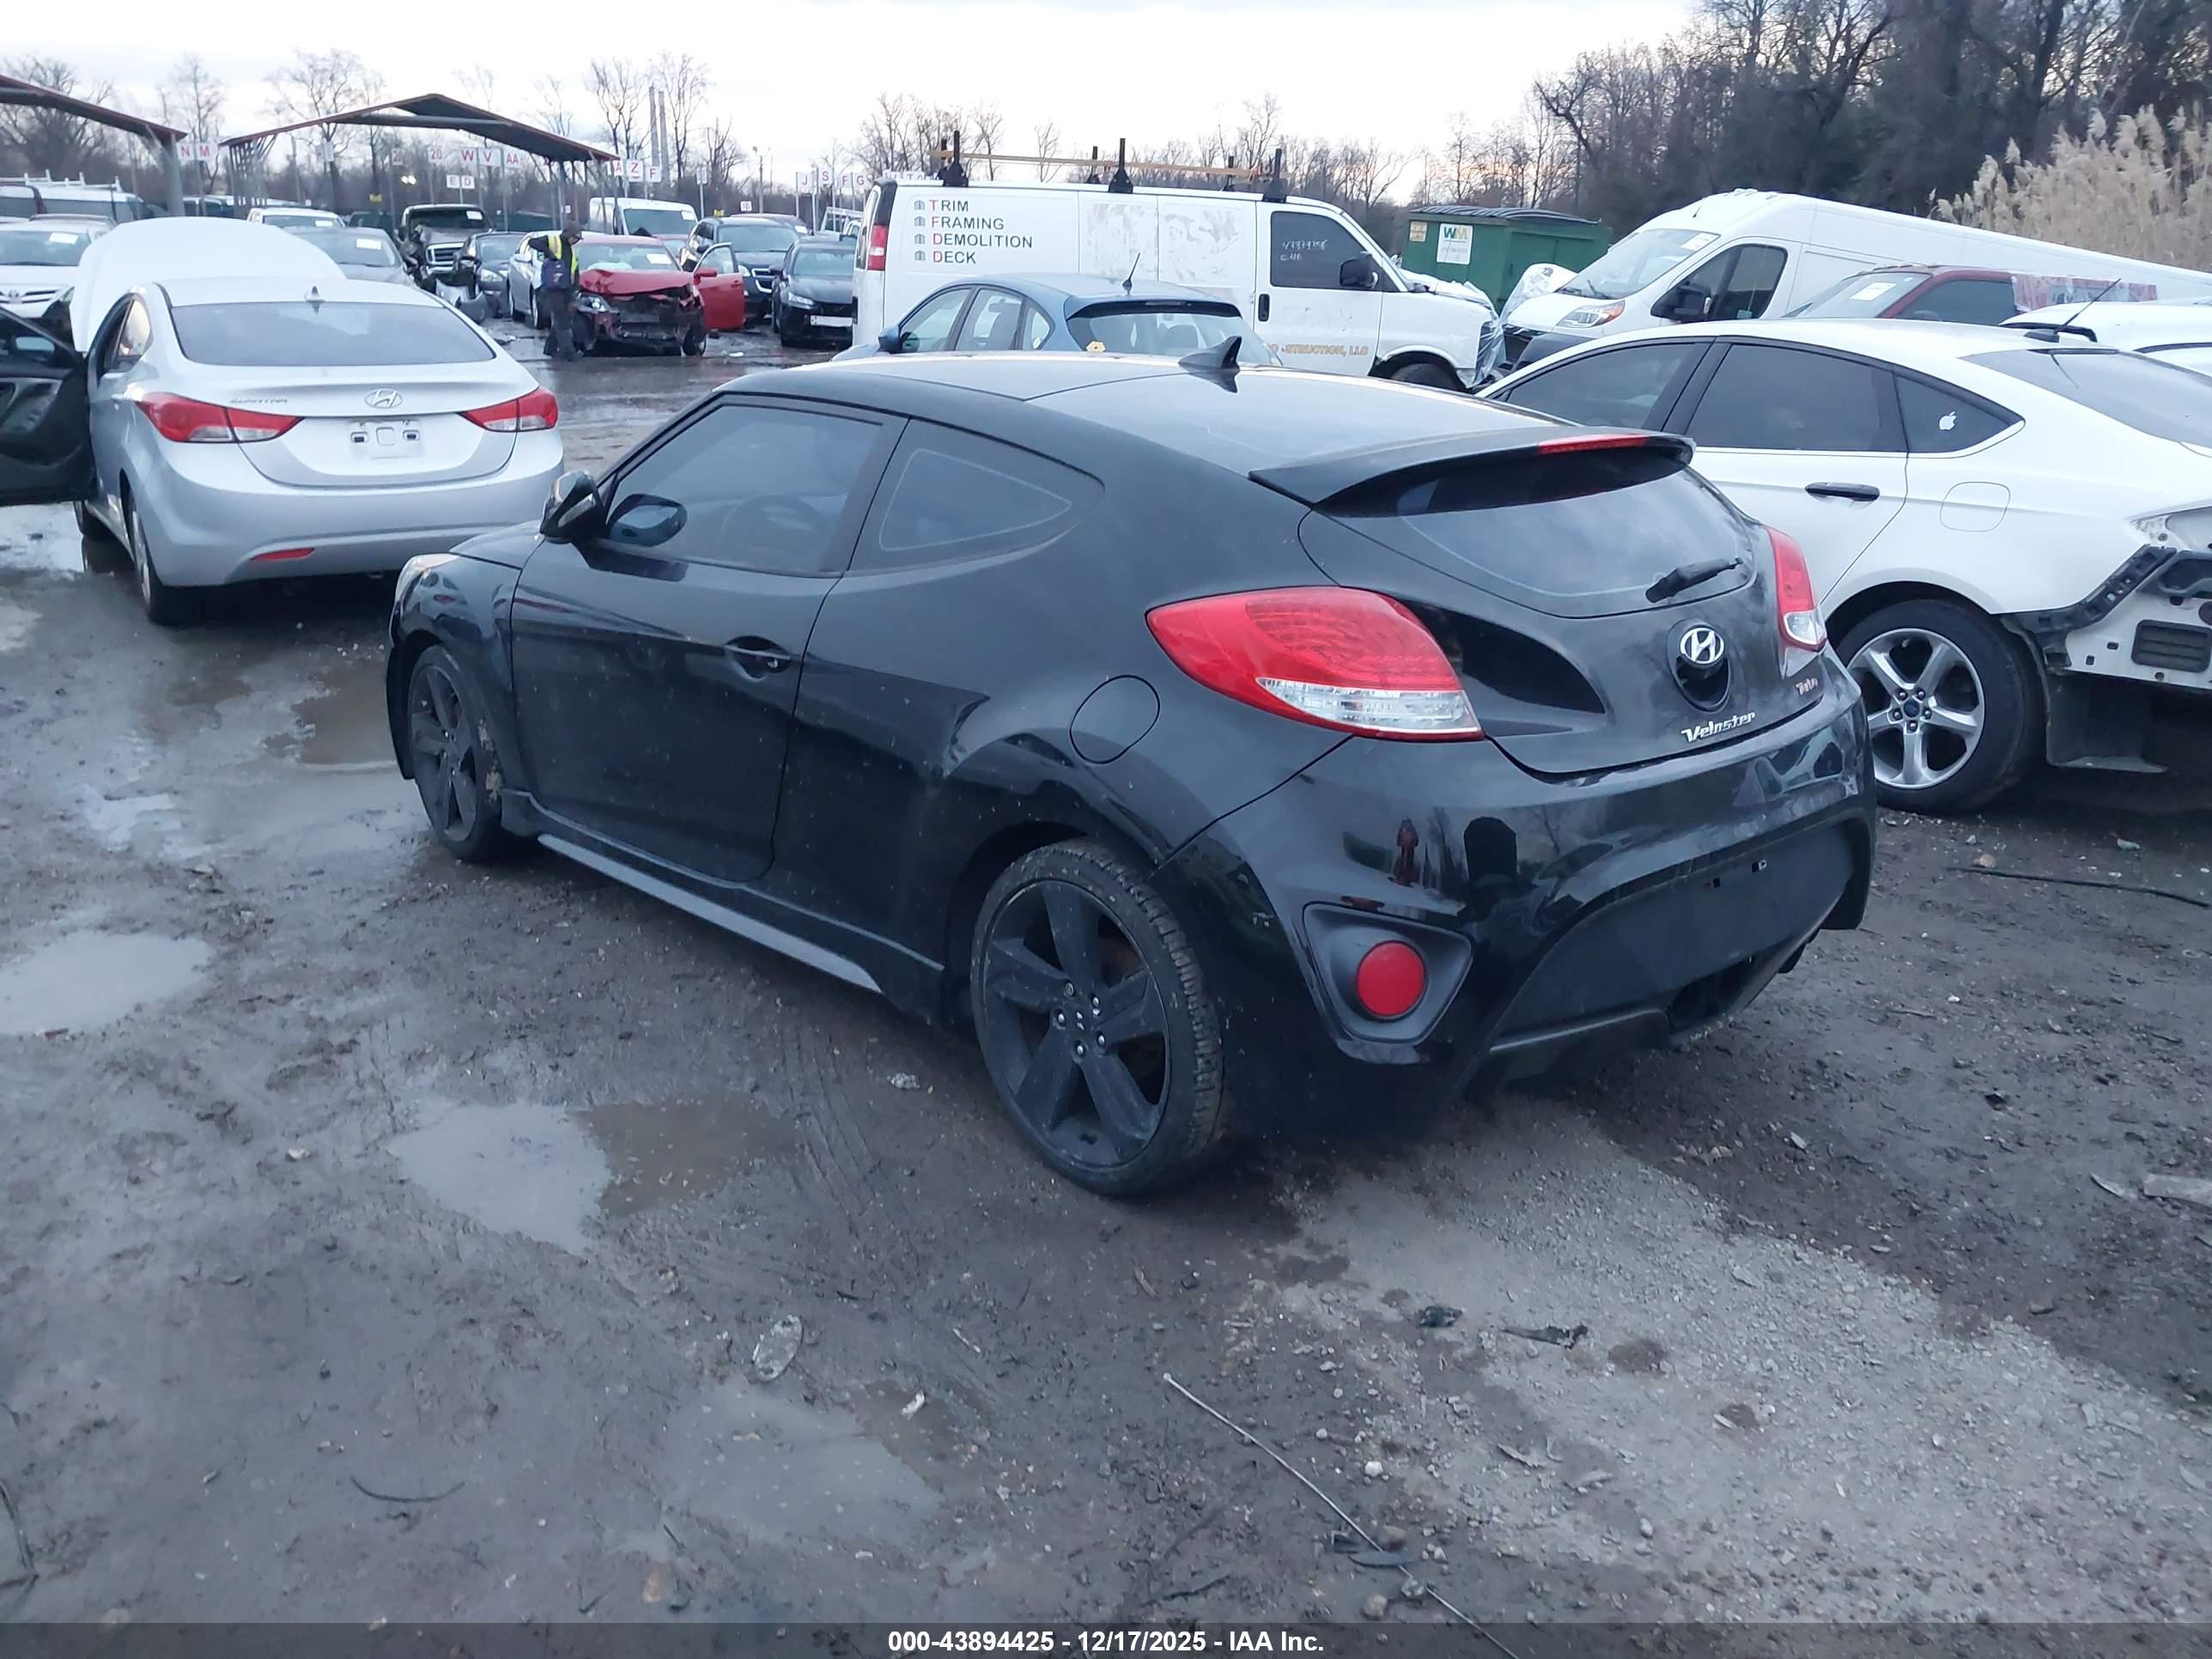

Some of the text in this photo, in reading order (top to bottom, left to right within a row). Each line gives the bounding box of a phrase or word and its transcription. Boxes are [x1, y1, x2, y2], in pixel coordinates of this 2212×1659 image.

[181, 146, 191, 157] N
[199, 145, 210, 157] M
[461, 149, 474, 161] W
[483, 150, 492, 161] V
[649, 167, 657, 179] F
[822, 171, 830, 181] S
[801, 175, 808, 185] J
[842, 176, 848, 186] F
[856, 175, 865, 185] G
[929, 199, 969, 212] TRIM
[931, 216, 1005, 230] FRAMING
[933, 233, 1033, 248] DEMOLITION
[933, 250, 976, 264] DECK
